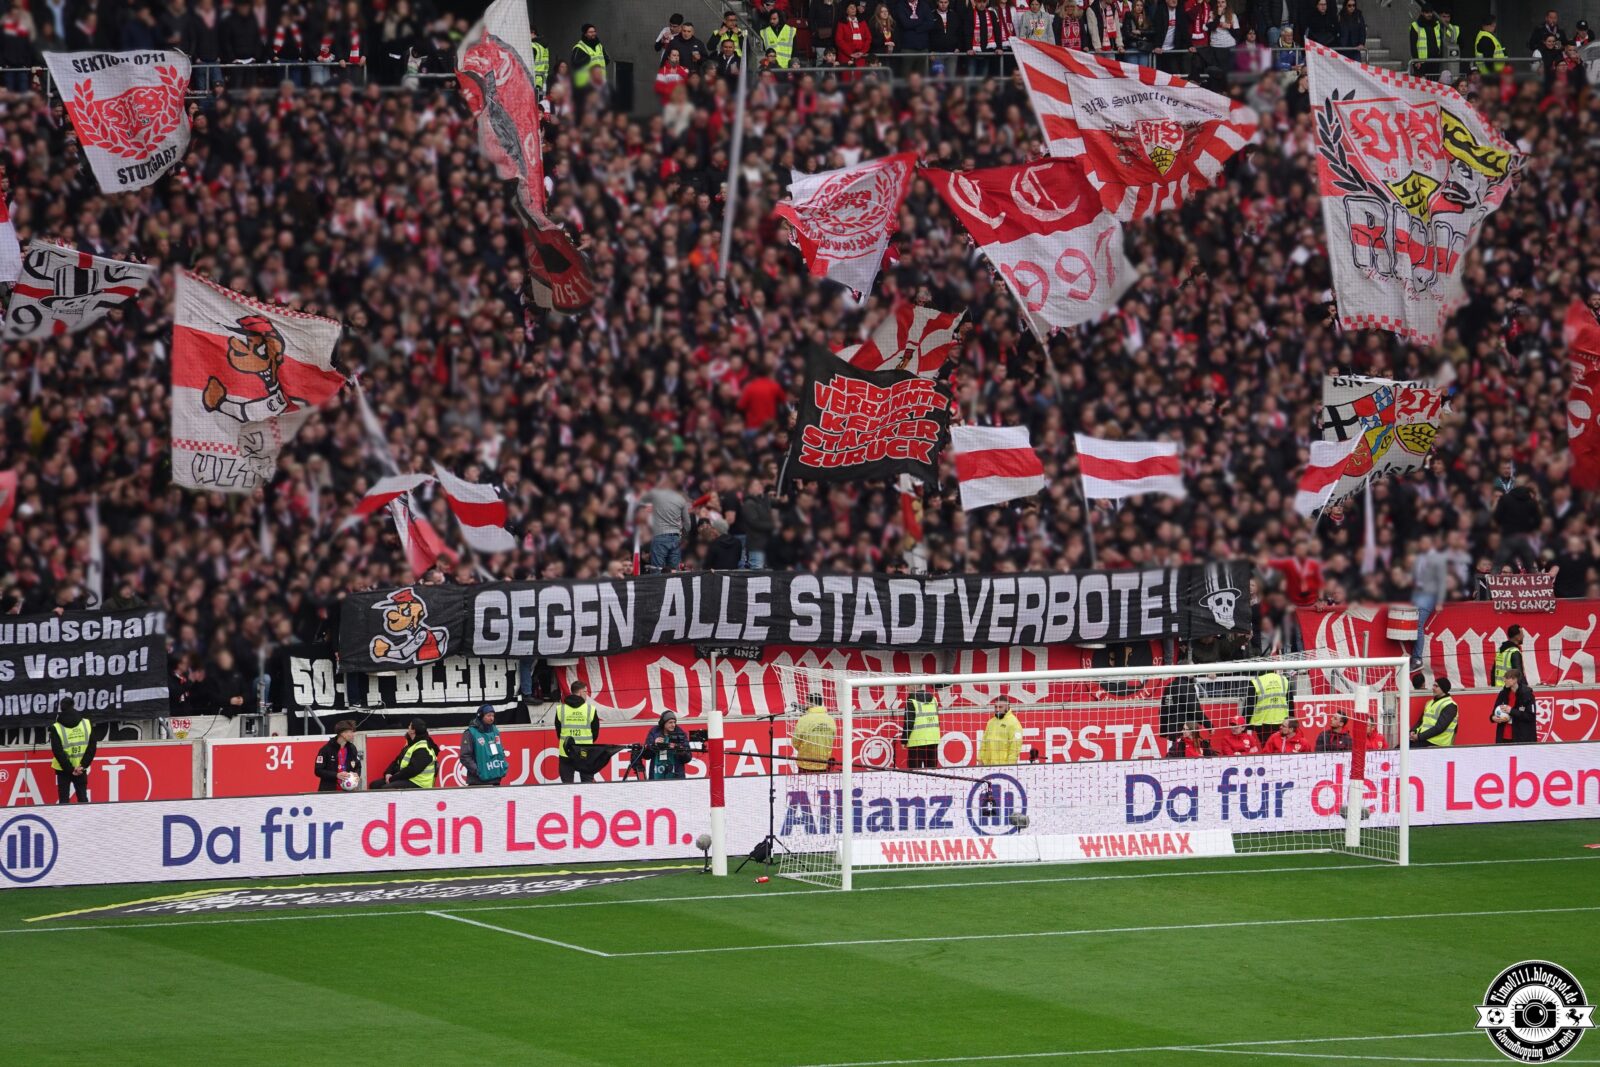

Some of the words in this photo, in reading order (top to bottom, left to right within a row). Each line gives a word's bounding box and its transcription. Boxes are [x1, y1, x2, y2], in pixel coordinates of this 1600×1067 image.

[133, 52, 165, 65] 0711
[829, 373, 937, 403] JEDER
[1491, 589, 1514, 598] DER
[1519, 588, 1554, 598] KAMPF
[1494, 600, 1518, 610] UMS
[1520, 600, 1556, 611] GANZE
[472, 580, 636, 656] GEGEN
[651, 574, 772, 643] ALLE
[789, 568, 1179, 645] STADTVERBOTE!
[24, 646, 149, 679] Verbot!
[1301, 703, 1328, 728] 35
[265, 744, 294, 771] 34
[1125, 774, 1199, 825] Da
[1217, 767, 1294, 820] für
[779, 787, 955, 837] Allianz
[162, 814, 240, 867] Da
[260, 806, 343, 862] für
[361, 801, 483, 858] dein
[506, 795, 693, 853] Leben.
[1078, 832, 1193, 857] WINAMAX
[881, 837, 997, 862] WINAMAX
